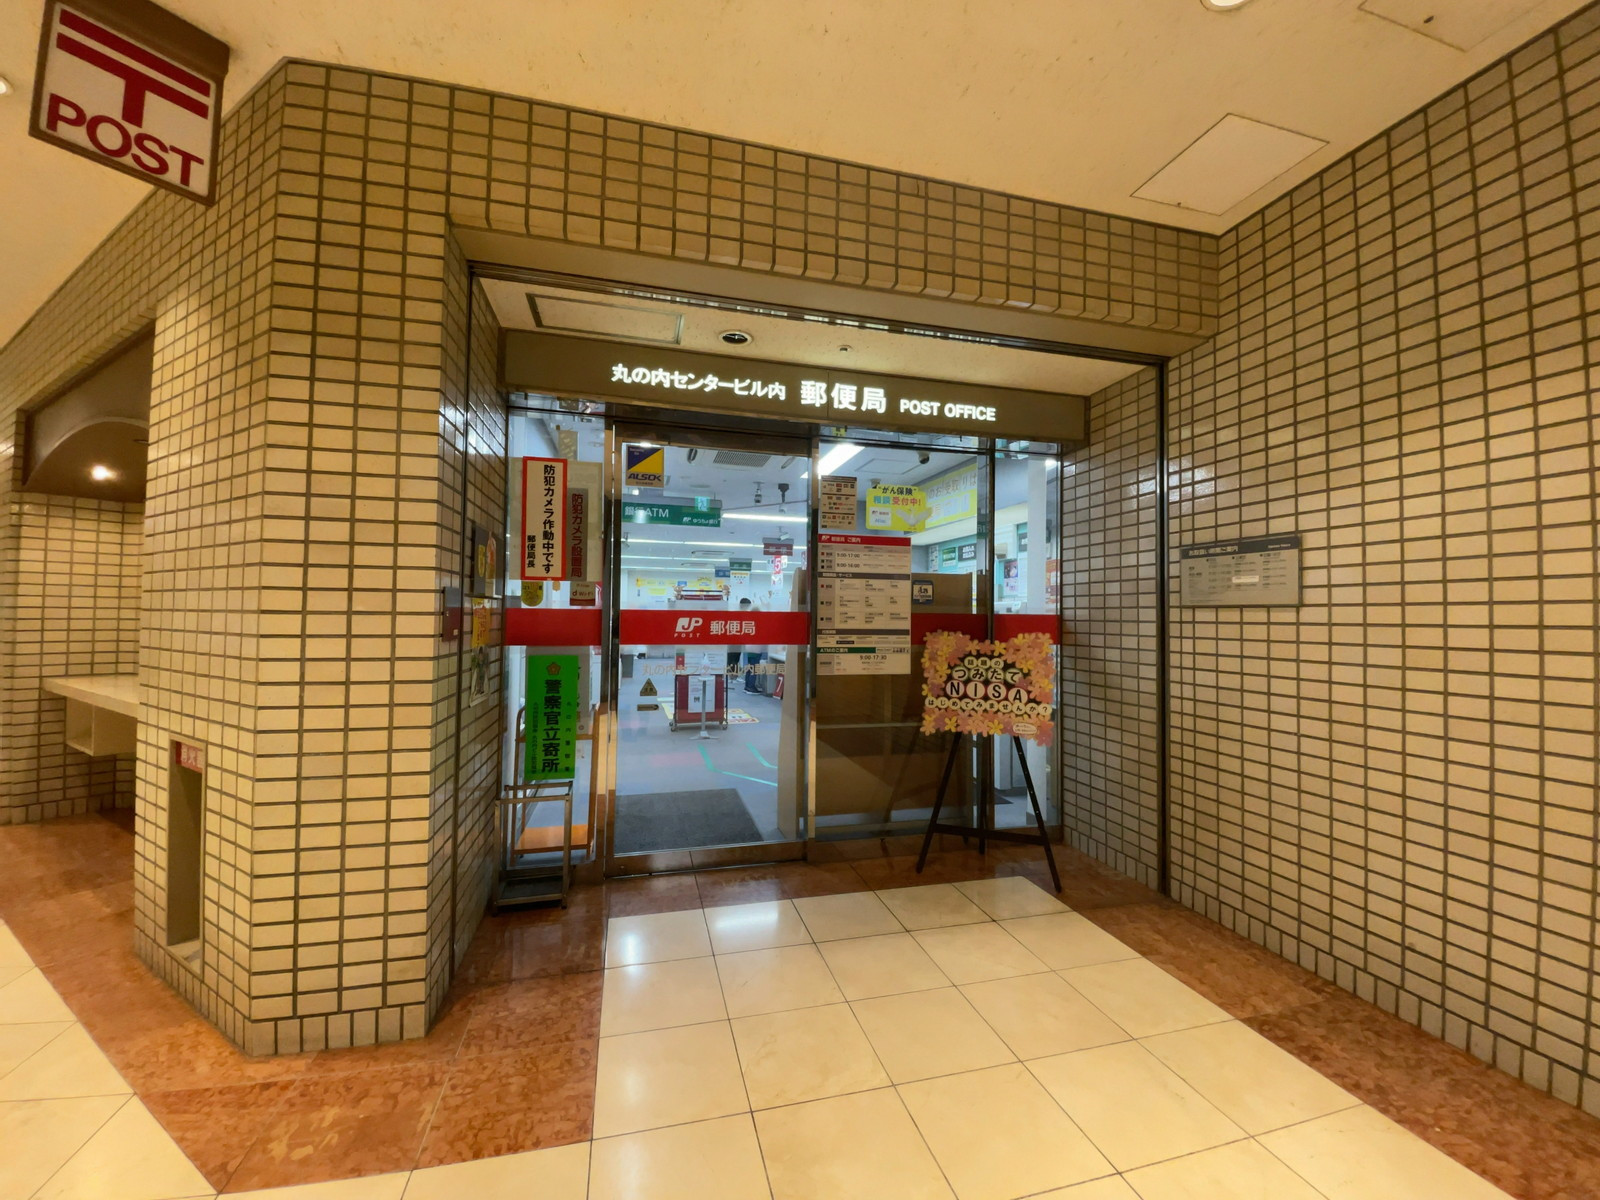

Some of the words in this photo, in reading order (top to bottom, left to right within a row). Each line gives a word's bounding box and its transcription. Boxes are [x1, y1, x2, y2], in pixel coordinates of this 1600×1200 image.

[46, 93, 205, 187] POST
[611, 363, 786, 400] 丸の内センタービル内
[800, 380, 886, 413] 郵便局
[899, 399, 940, 416] POST
[944, 403, 996, 421] OFFICE
[627, 473, 662, 482] ALSOK
[542, 464, 555, 574] 防犯カメラ作動中です
[526, 534, 536, 568] 郵便局長
[710, 620, 756, 636] 郵便局
[949, 681, 1023, 704] NISA
[954, 668, 1020, 684] つみたて
[541, 679, 562, 774] 警察官立寄所
